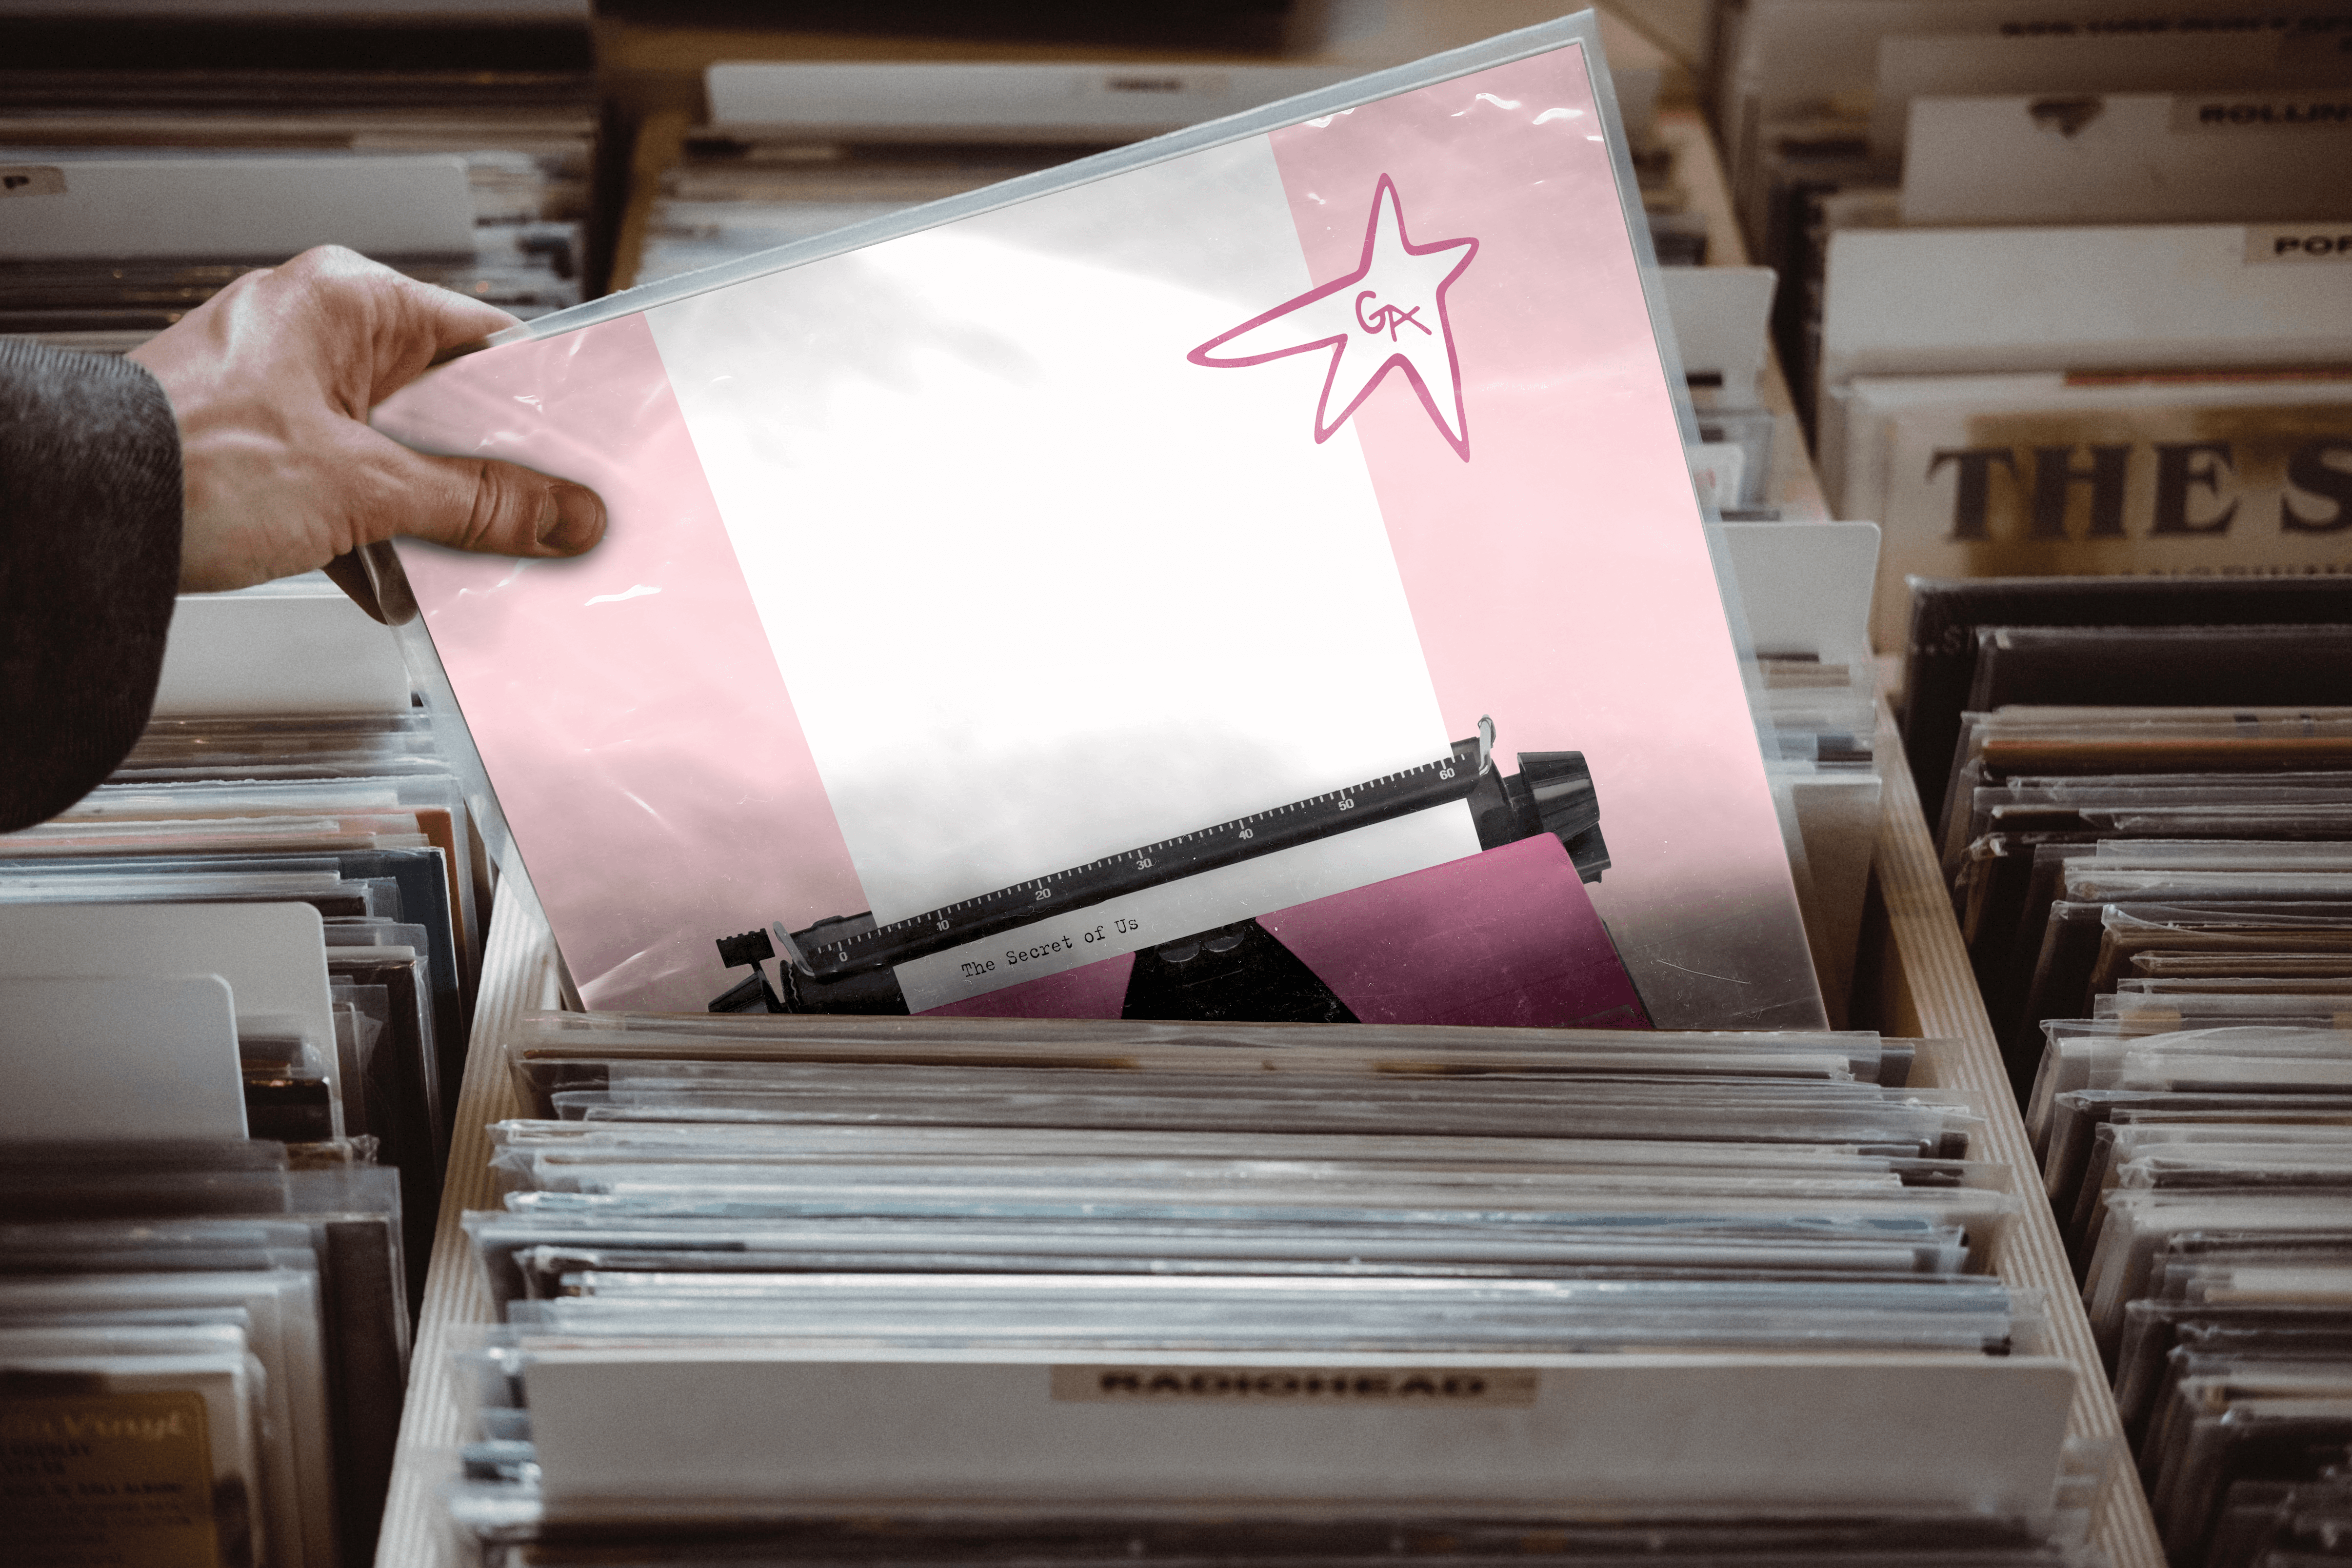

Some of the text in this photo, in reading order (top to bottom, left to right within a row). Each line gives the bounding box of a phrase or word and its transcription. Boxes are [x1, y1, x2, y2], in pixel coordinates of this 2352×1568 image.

[1925, 440, 2240, 543] THE
[937, 919, 950, 931] 10
[1035, 888, 1051, 900] 20
[1136, 858, 1152, 870] 30
[1238, 828, 1254, 840] 40
[1338, 798, 1354, 811] 50
[1439, 767, 1455, 780] 60
[961, 918, 1139, 977] The Secret of Us
[1099, 1370, 1487, 1398] RADIOHEAD
